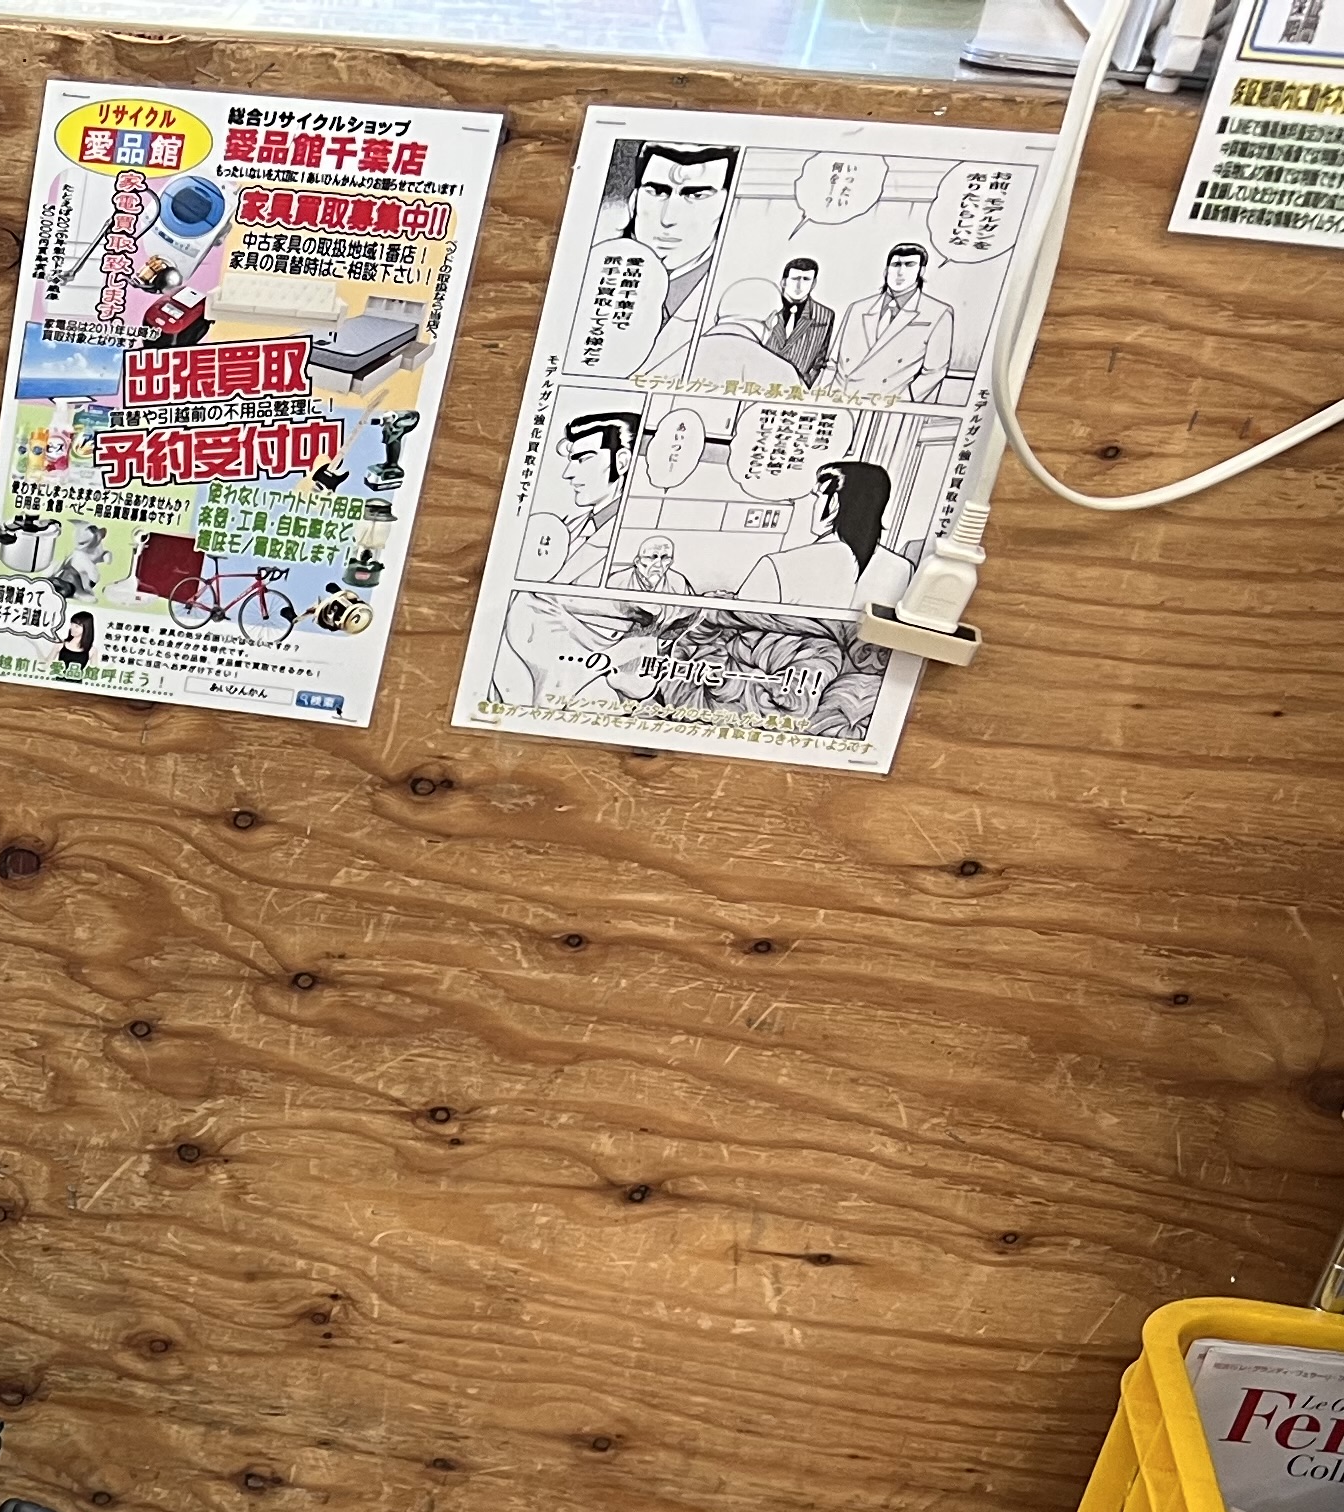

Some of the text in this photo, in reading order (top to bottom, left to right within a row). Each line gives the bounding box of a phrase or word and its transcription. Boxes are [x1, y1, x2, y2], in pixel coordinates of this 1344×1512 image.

[96, 103, 177, 129] リサイクル
[227, 107, 411, 137] 総合リサイクルショップ
[81, 129, 182, 167] 愛品館
[222, 127, 429, 176] 愛品館千葉店
[948, 171, 988, 246] 売りたいらしいな
[972, 171, 1012, 250] お前、モデルガンを
[128, 343, 309, 401] 出張買取
[97, 422, 342, 483] 予約受付中
[206, 482, 365, 520] 使わないアウトドア用品
[536, 534, 552, 557] はい
